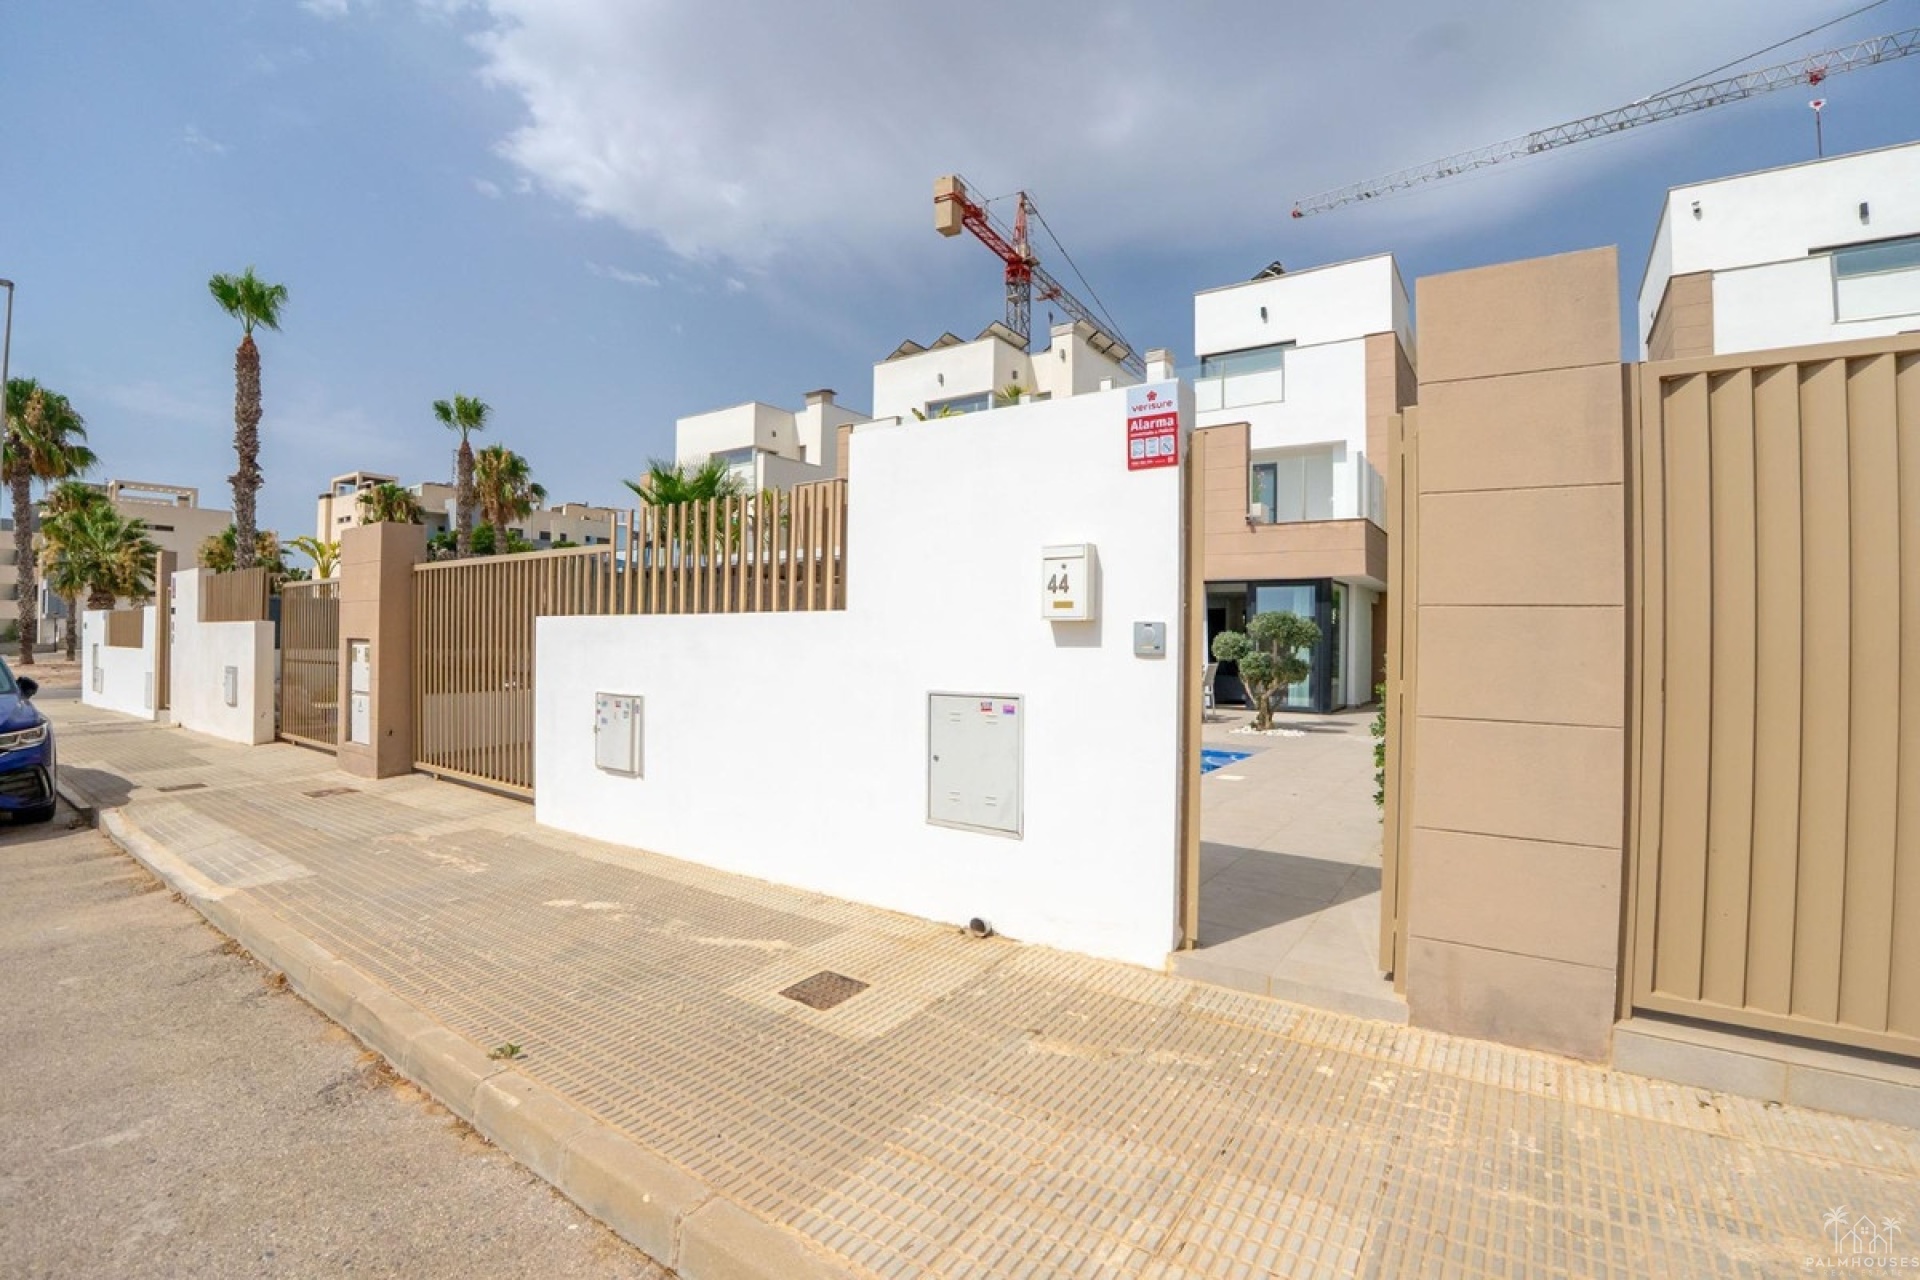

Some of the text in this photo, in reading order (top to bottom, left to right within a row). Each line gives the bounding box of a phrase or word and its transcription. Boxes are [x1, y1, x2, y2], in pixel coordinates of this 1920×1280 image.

[1131, 400, 1173, 412] verisure
[1130, 417, 1174, 431] Alarma
[1047, 573, 1070, 594] 44
